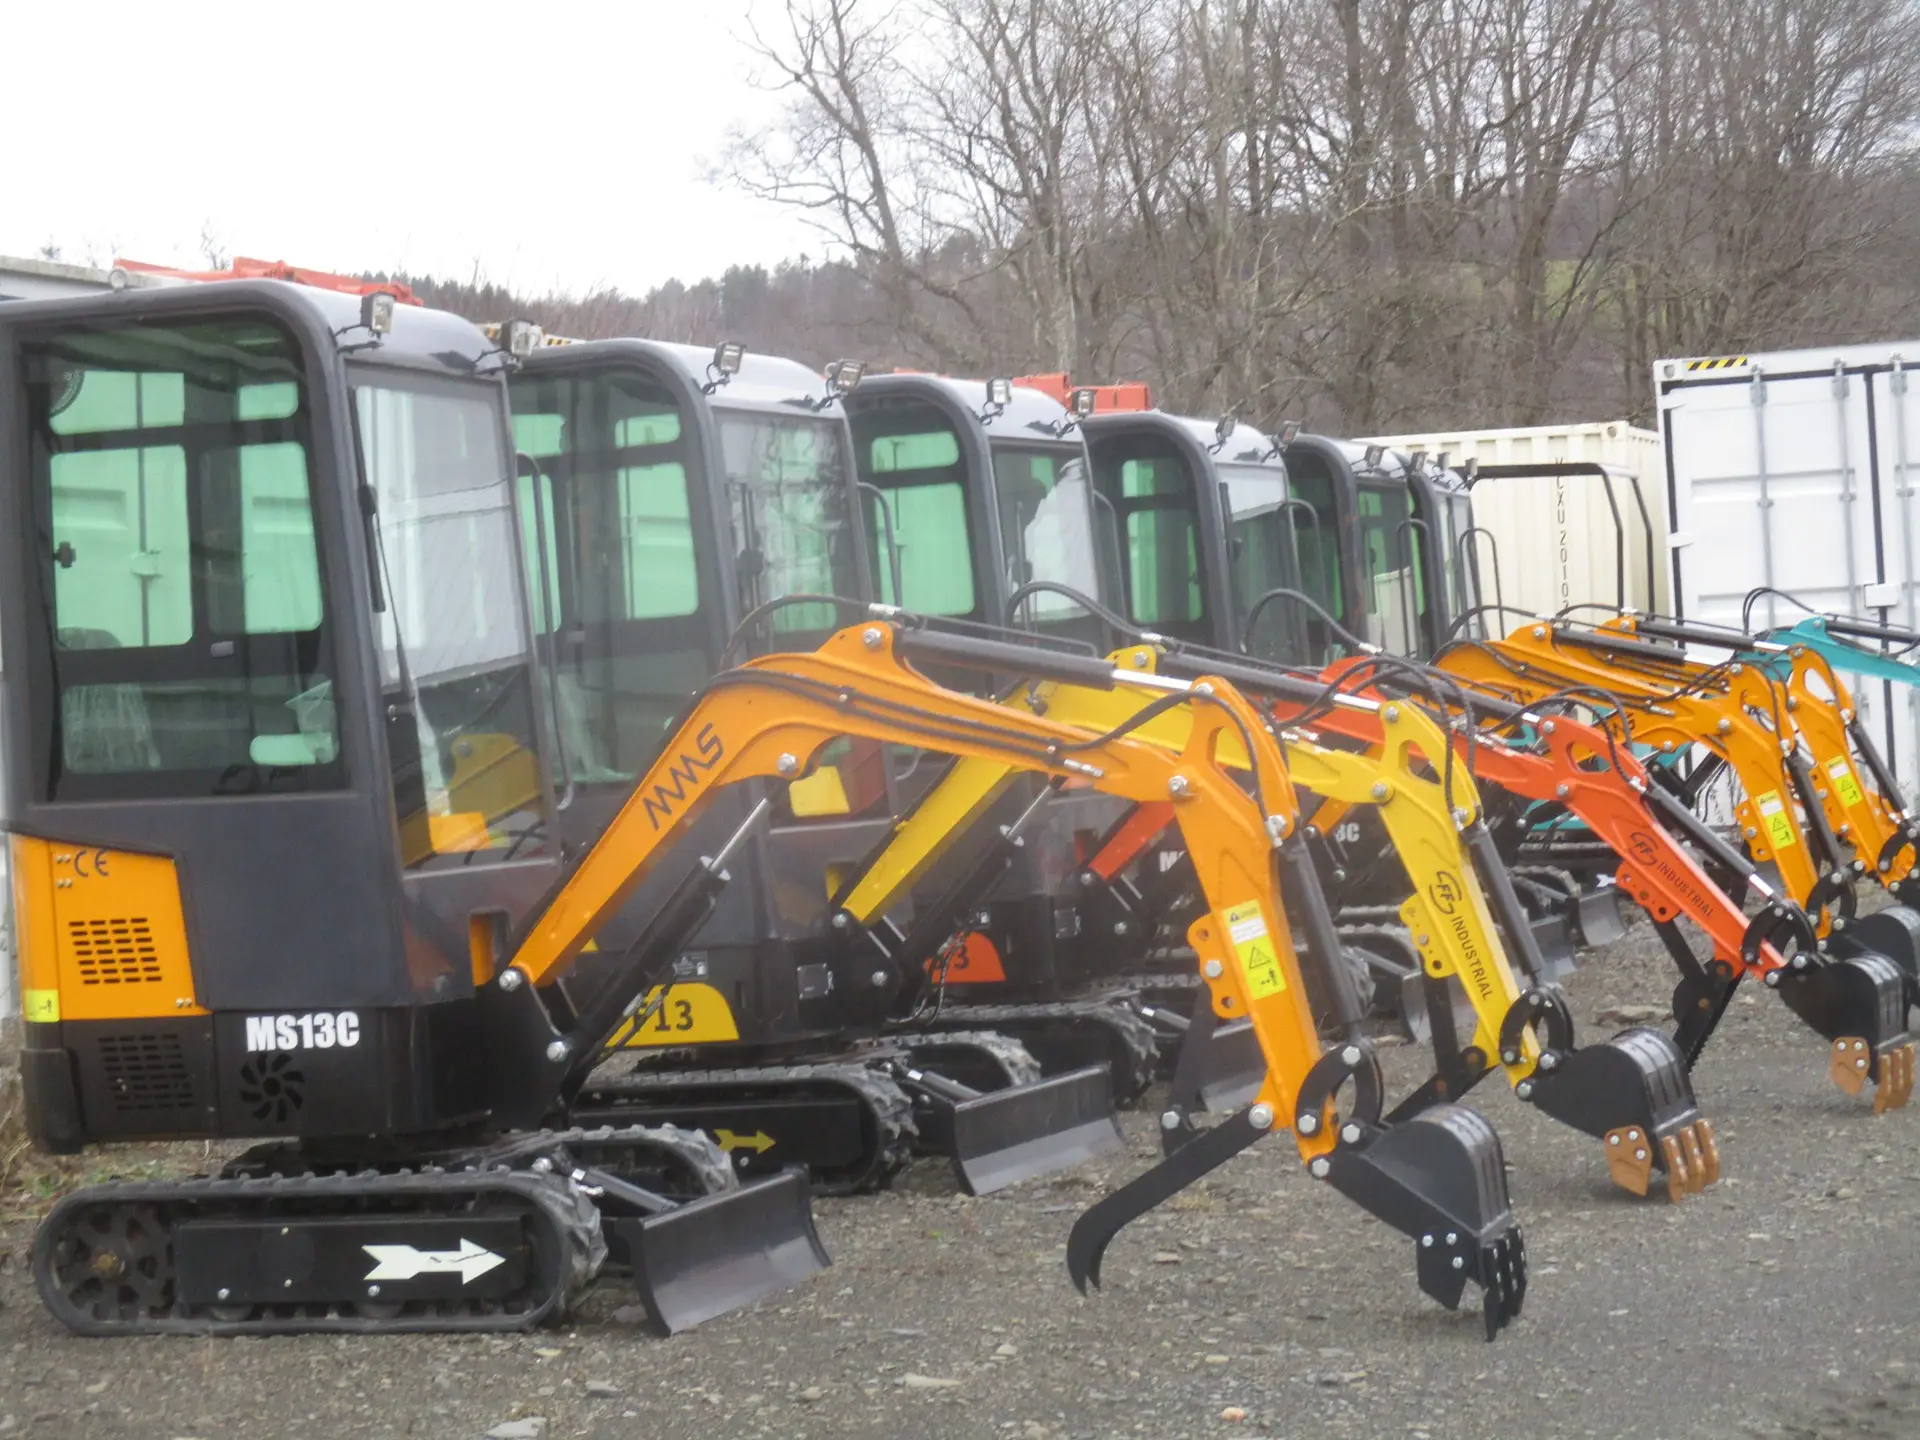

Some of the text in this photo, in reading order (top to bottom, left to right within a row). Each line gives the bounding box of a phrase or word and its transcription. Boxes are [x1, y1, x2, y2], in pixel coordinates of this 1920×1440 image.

[74, 848, 109, 878] CE
[1657, 861, 1714, 917] INDUSTRIAL
[1451, 915, 1493, 1001] INDUSTRIAL
[246, 1011, 360, 1052] MS13C
